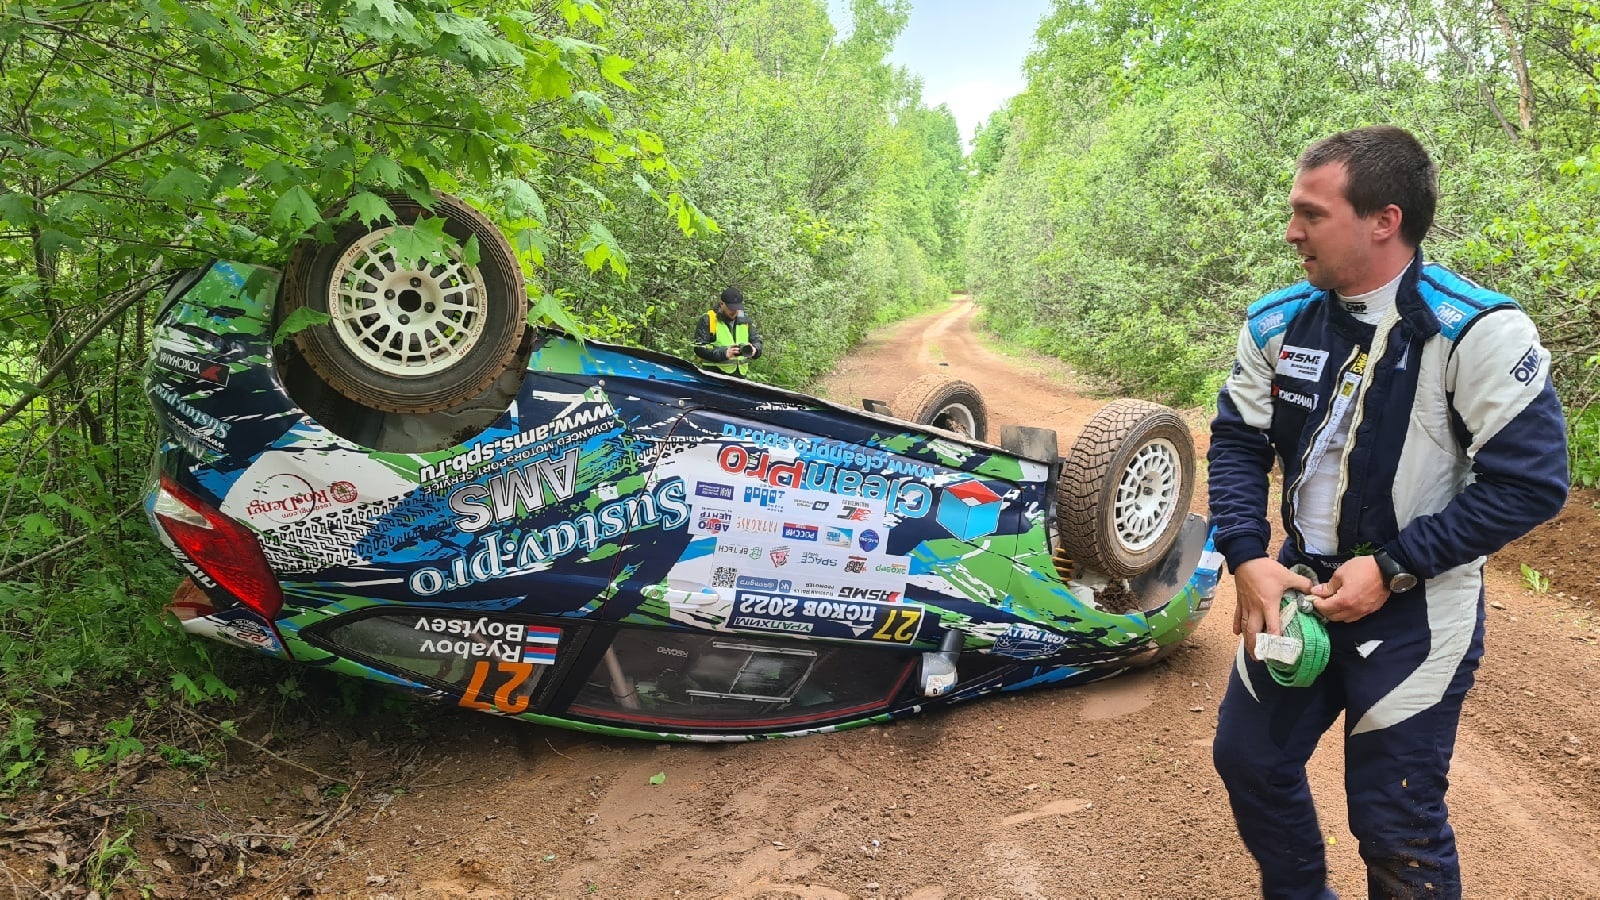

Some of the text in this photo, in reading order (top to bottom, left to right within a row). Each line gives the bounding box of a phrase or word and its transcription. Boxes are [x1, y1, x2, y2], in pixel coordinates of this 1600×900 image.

[1345, 303, 1368, 312] OMP
[1436, 305, 1463, 324] OMP
[1258, 312, 1284, 333] OMP
[1514, 348, 1539, 382] OMP
[419, 403, 615, 485] www.ams.spb.ru
[422, 419, 615, 495] ADVANCED MOTORSPORT SERVICE
[723, 424, 936, 480] www.cleanpro.spb.ru
[448, 448, 580, 533] AMS
[717, 445, 933, 518] CleanPro
[246, 490, 330, 520] RosDengi
[281, 503, 332, 519] rosdengi.com
[700, 511, 732, 521] ЦЕНТР
[408, 478, 690, 597] Sustav.pro
[698, 521, 730, 533] АВТО
[785, 529, 815, 540] РОССИЯ
[801, 556, 838, 567] SPACE
[739, 594, 877, 622] ПСКОВ 2022
[414, 617, 524, 643] Boytsev
[735, 617, 811, 632] УРАЛХИМ
[872, 609, 920, 641] 27
[419, 638, 522, 664] Ryabov
[458, 661, 533, 714] 27
